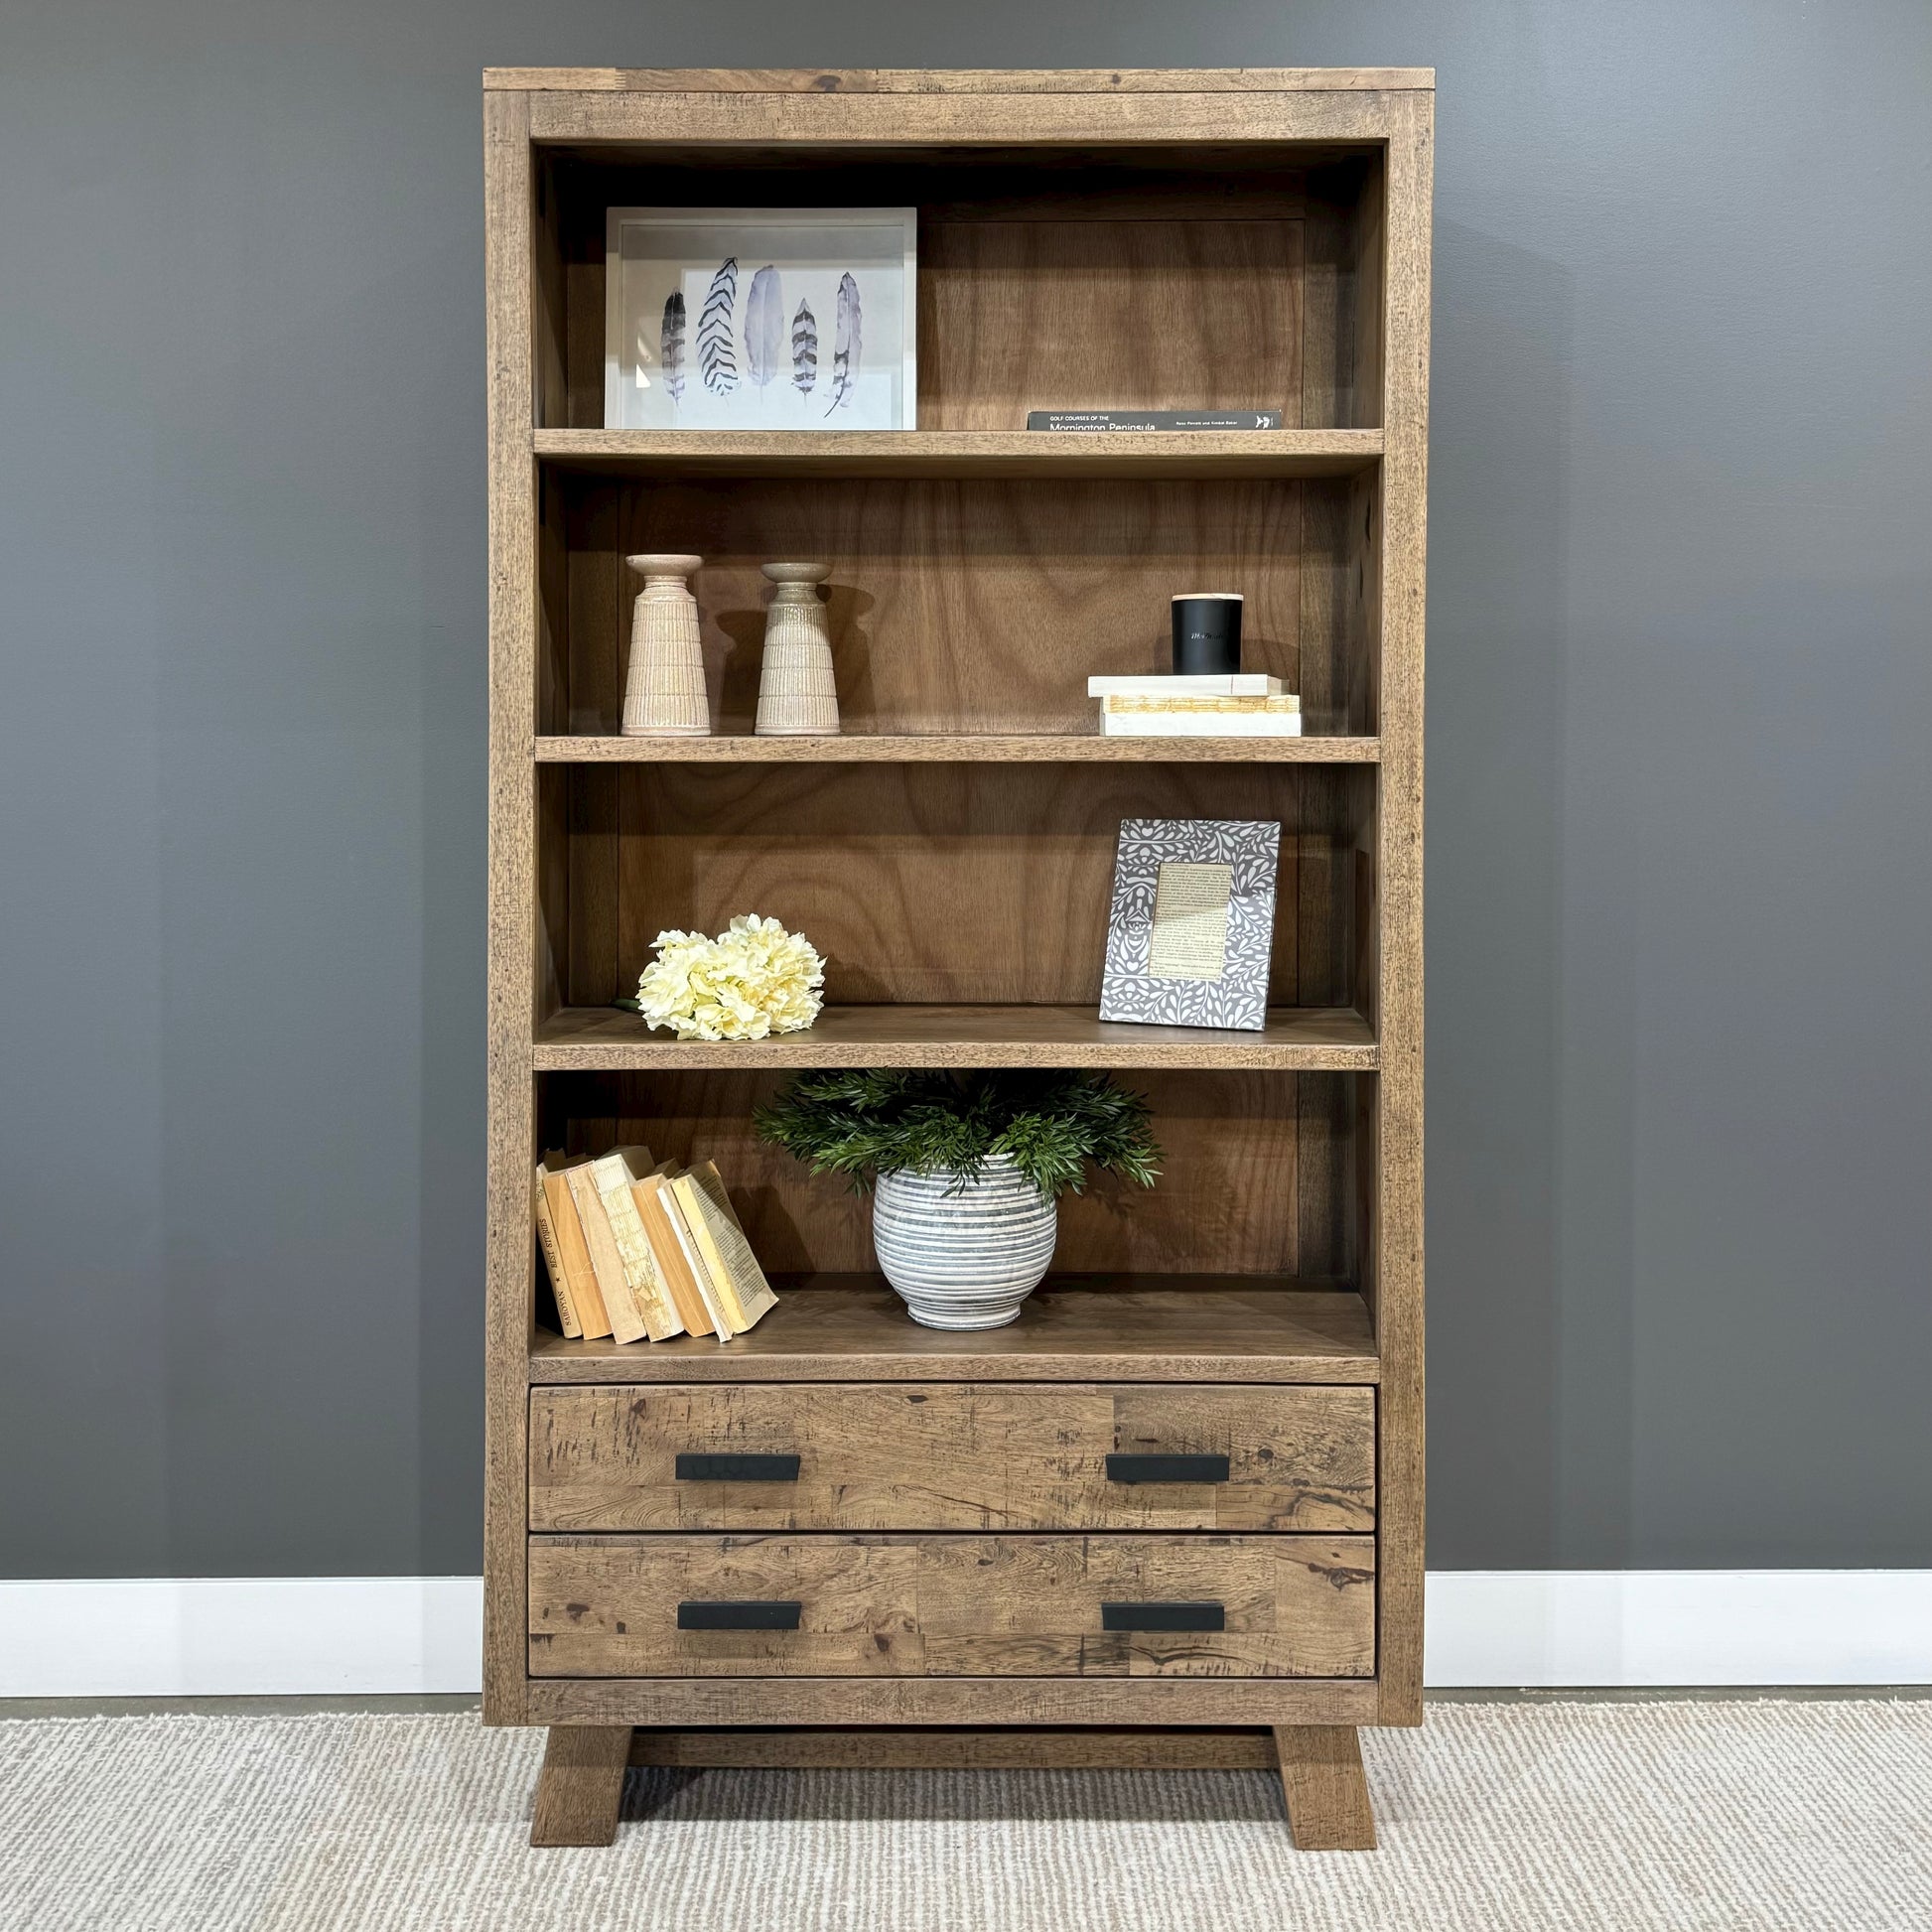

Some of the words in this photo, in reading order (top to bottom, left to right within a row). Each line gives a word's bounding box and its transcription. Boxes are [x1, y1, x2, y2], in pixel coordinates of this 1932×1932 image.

[539, 1217, 553, 1248] STORIES
[548, 1251, 558, 1269] BEST
[558, 1291, 572, 1326] SAROYAN
